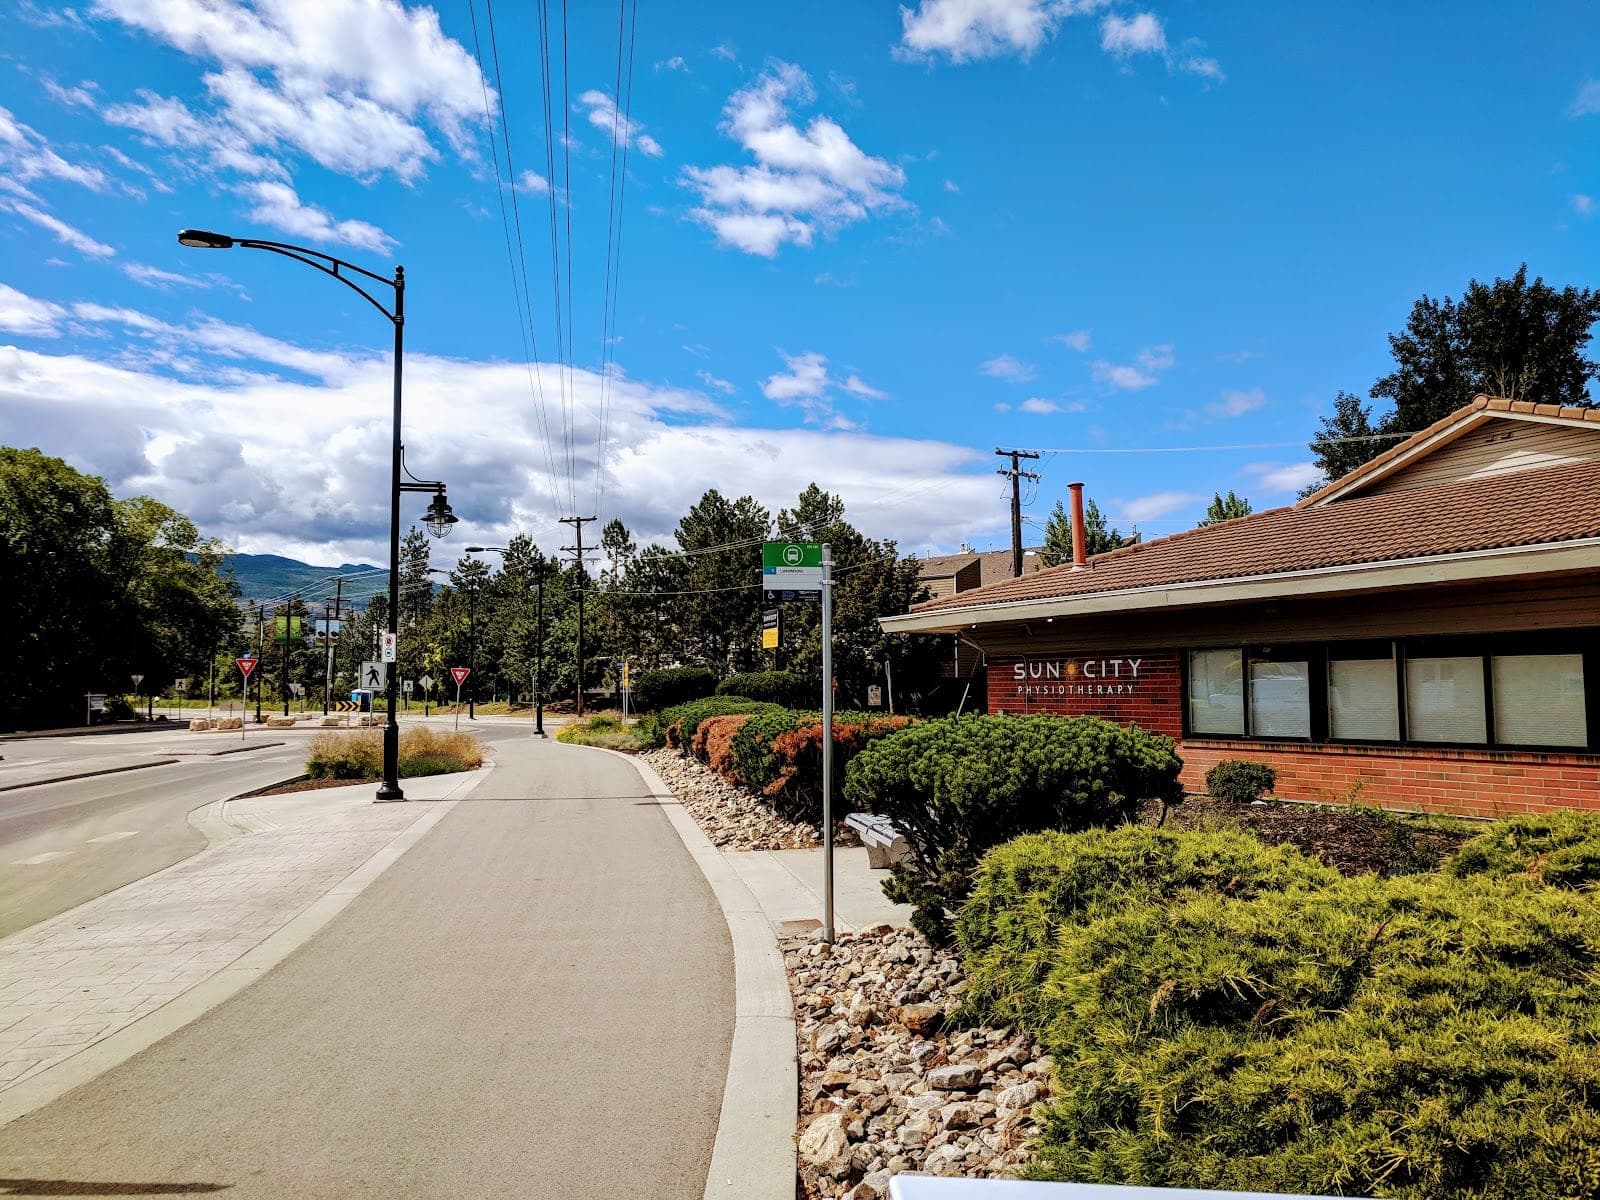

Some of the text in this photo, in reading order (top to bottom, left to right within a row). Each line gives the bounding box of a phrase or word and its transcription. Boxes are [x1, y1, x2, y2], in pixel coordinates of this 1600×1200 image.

[1013, 659, 1142, 680] SUN CITY
[1017, 684, 1134, 695] PHYSIOTHERAPY
